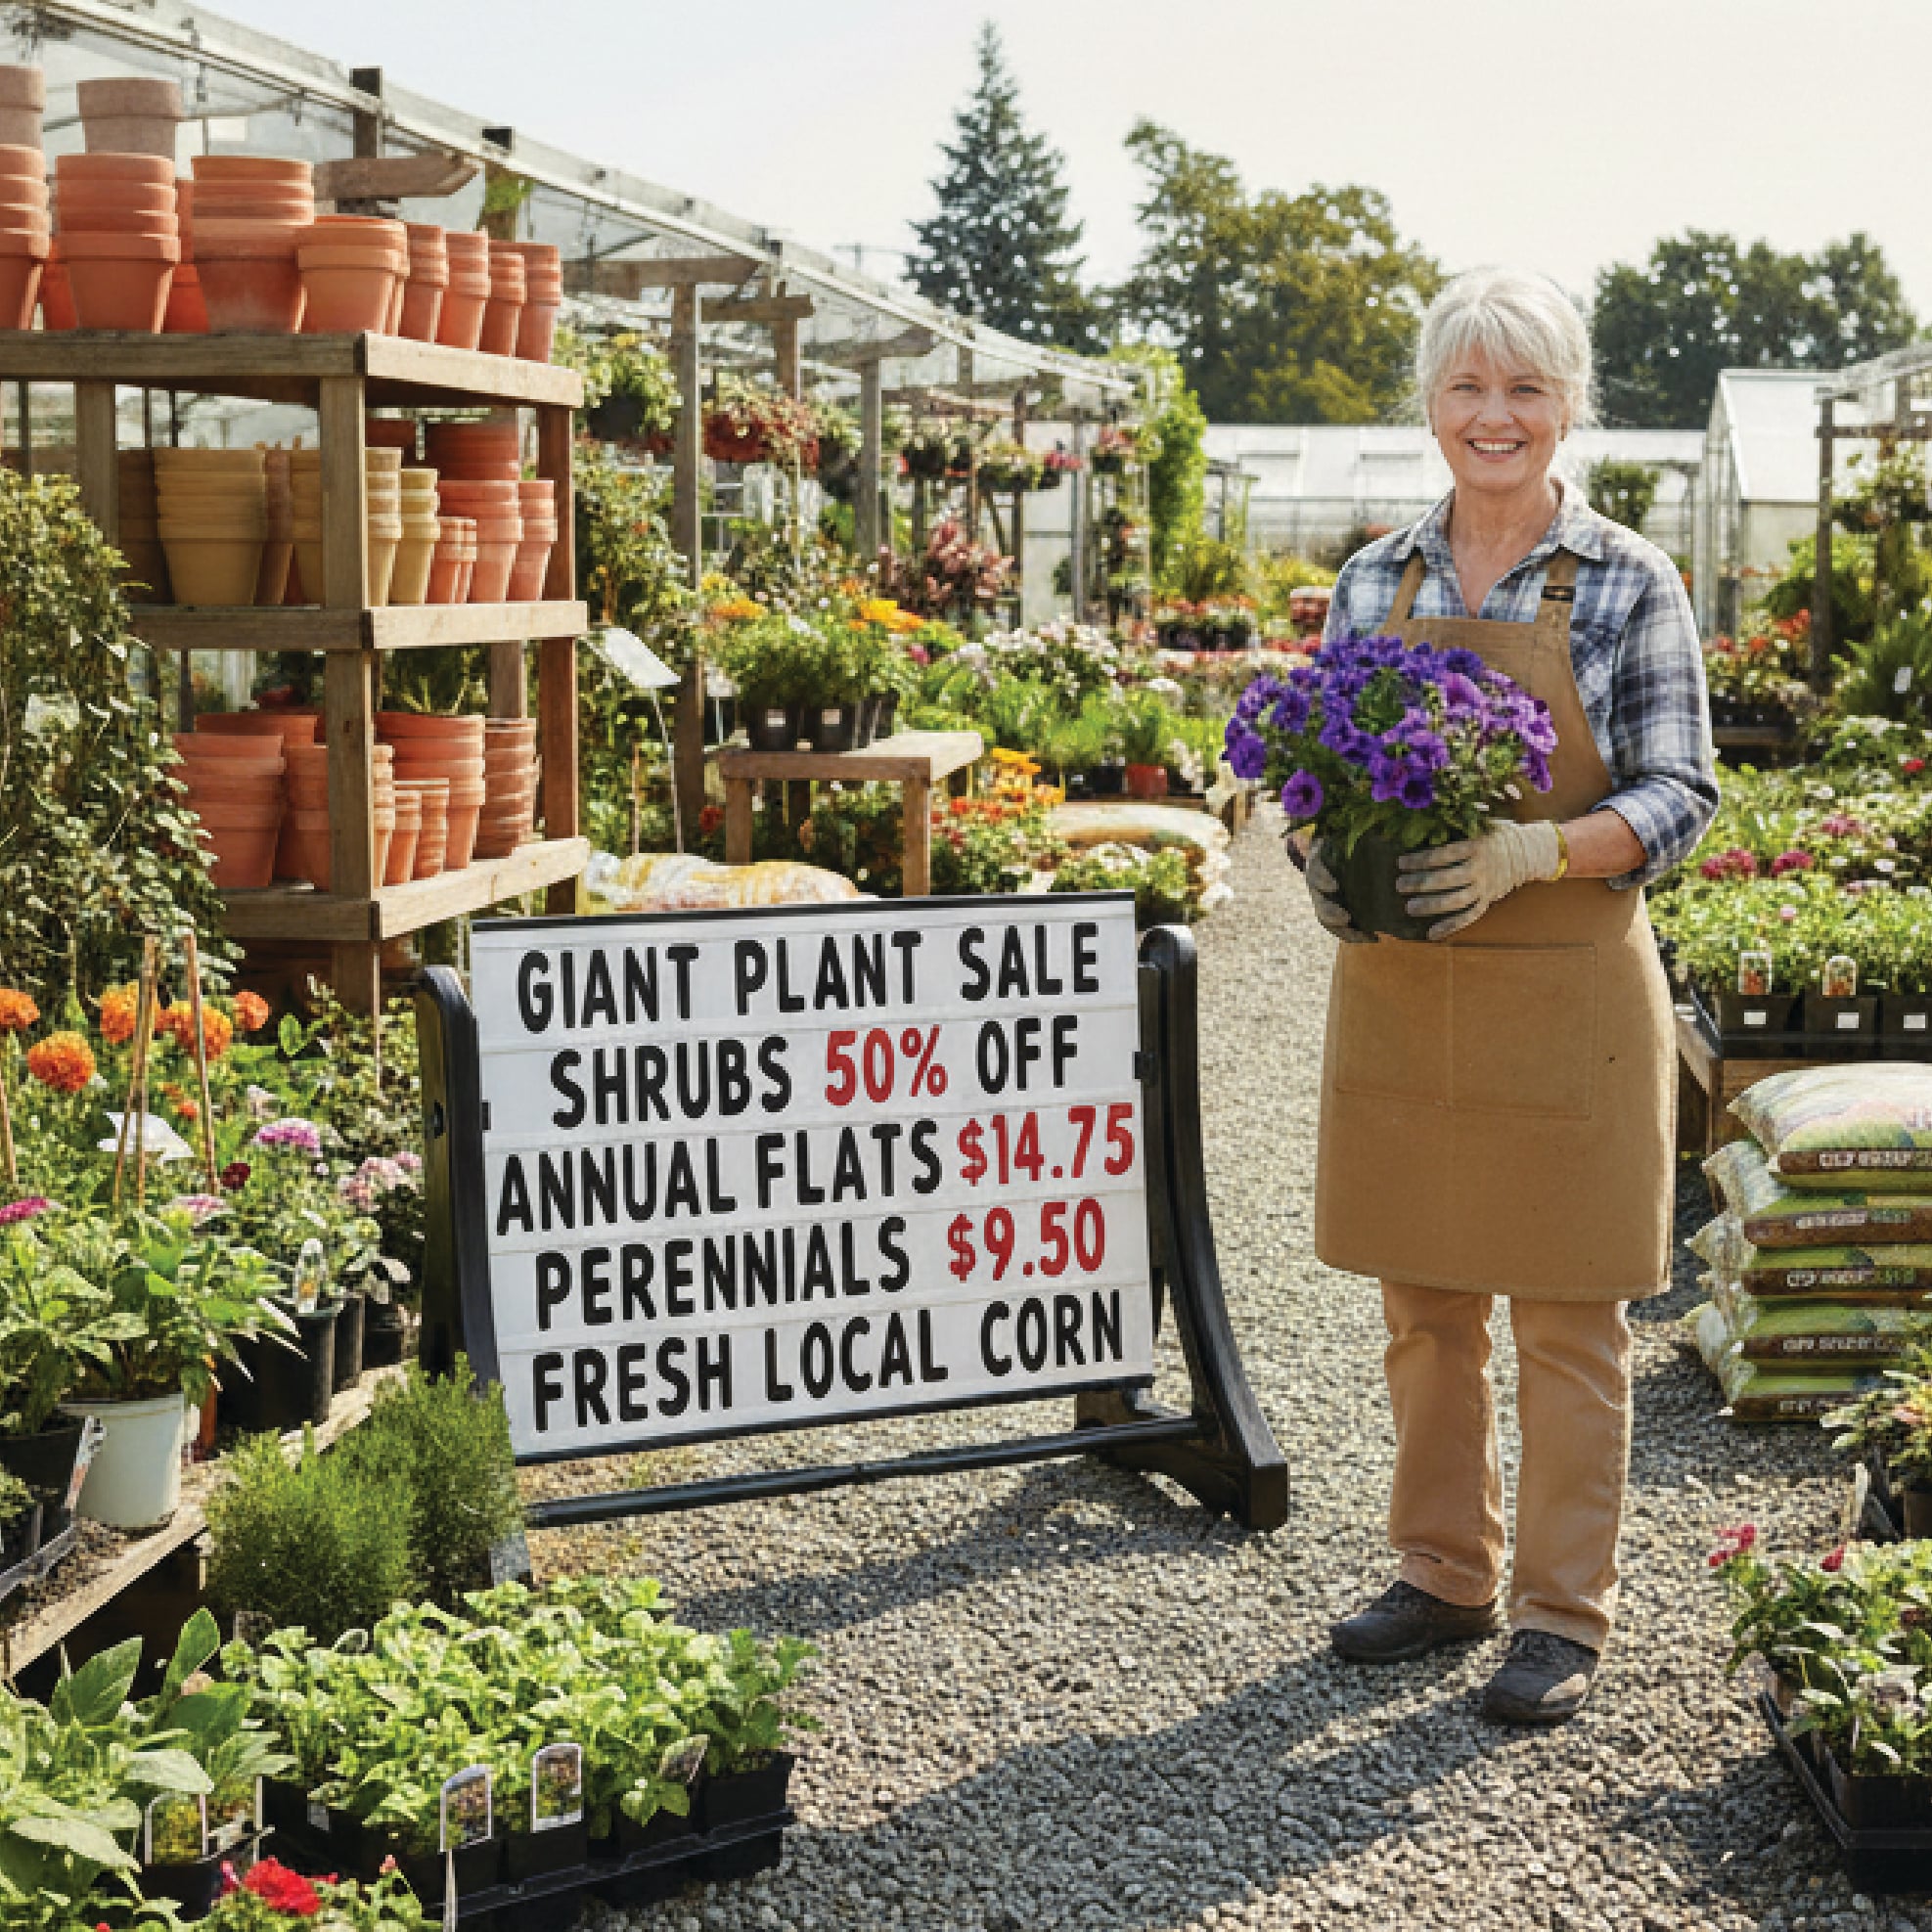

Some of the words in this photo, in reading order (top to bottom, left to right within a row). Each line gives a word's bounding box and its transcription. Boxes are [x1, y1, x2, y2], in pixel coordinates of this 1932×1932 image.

[518, 943, 698, 1034] GIANT
[735, 931, 922, 1015] PLANT
[960, 922, 1099, 1001] SALE
[551, 1036, 791, 1130] SHRUBS
[825, 1024, 948, 1105] 50%
[978, 1015, 1077, 1094] OFF
[497, 1139, 736, 1236] ANNUAL
[755, 1118, 942, 1208] FLATS
[958, 1102, 1135, 1187] $14.75
[536, 1216, 909, 1331] PERENNIALS
[948, 1196, 1104, 1281] $9.50
[533, 1334, 733, 1432] FRESH
[765, 1310, 949, 1402] LOCAL
[981, 1289, 1122, 1376] CORN
